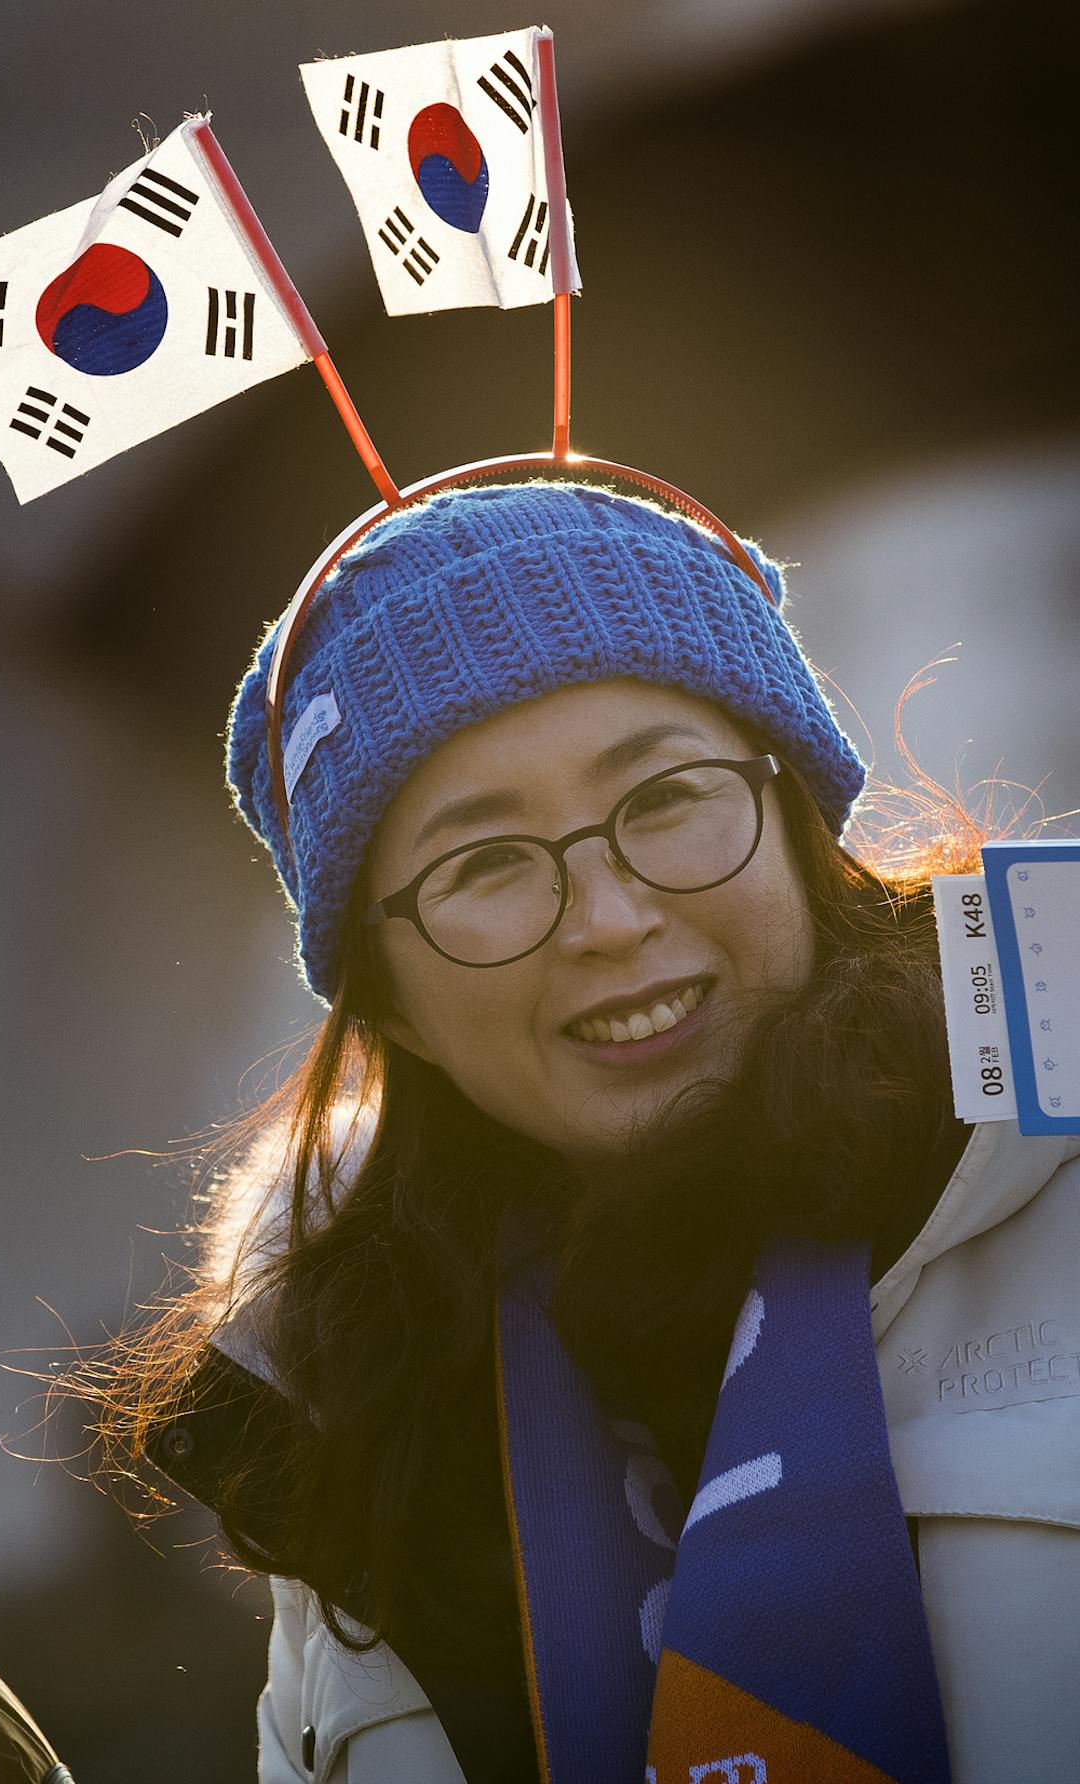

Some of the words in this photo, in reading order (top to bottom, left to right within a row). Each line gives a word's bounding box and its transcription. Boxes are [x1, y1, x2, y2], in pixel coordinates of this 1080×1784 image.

[962, 893, 987, 938] K48
[970, 966, 991, 1015] 09:05
[978, 1046, 991, 1064] 2월
[991, 1047, 1000, 1063] FEB
[981, 1066, 1004, 1097] 08
[940, 1320, 1060, 1369] ARCTIC
